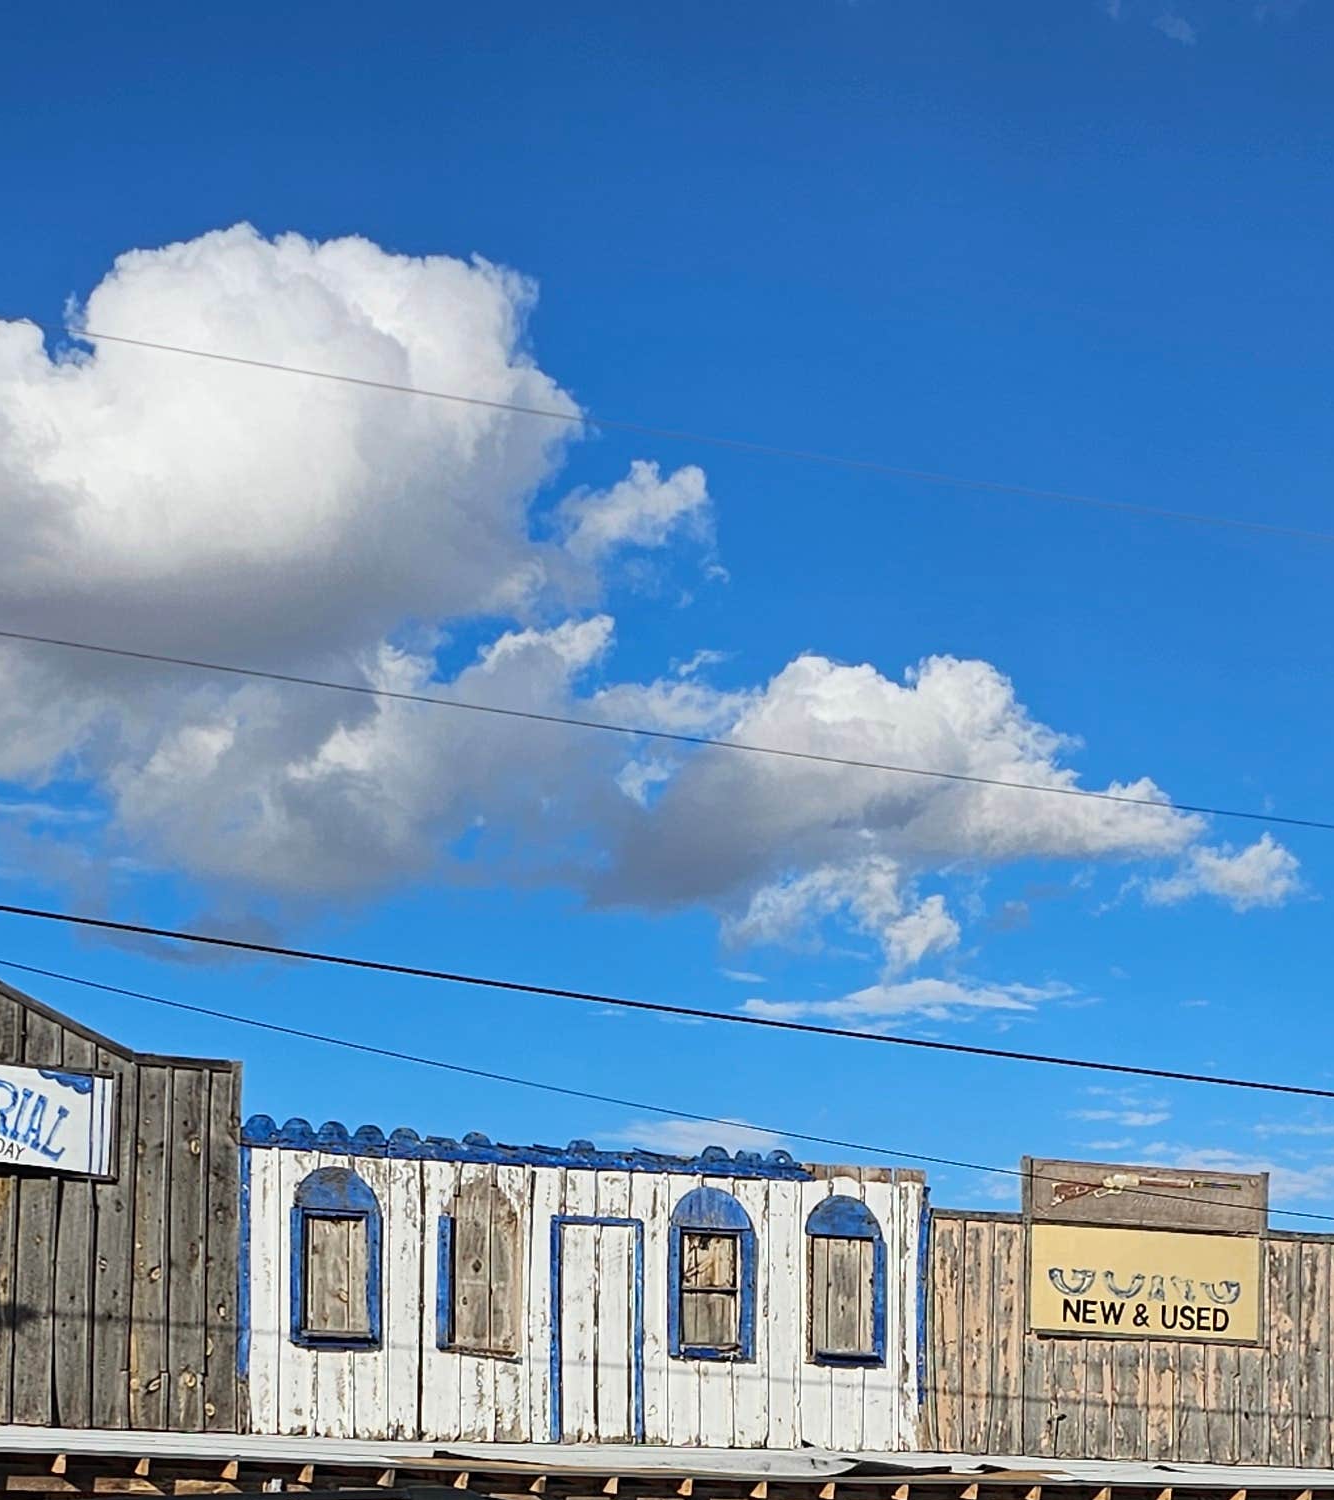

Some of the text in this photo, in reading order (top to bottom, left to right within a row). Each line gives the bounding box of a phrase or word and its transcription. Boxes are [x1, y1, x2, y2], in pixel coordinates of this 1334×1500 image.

[1063, 1299, 1230, 1332] NEW & USED
